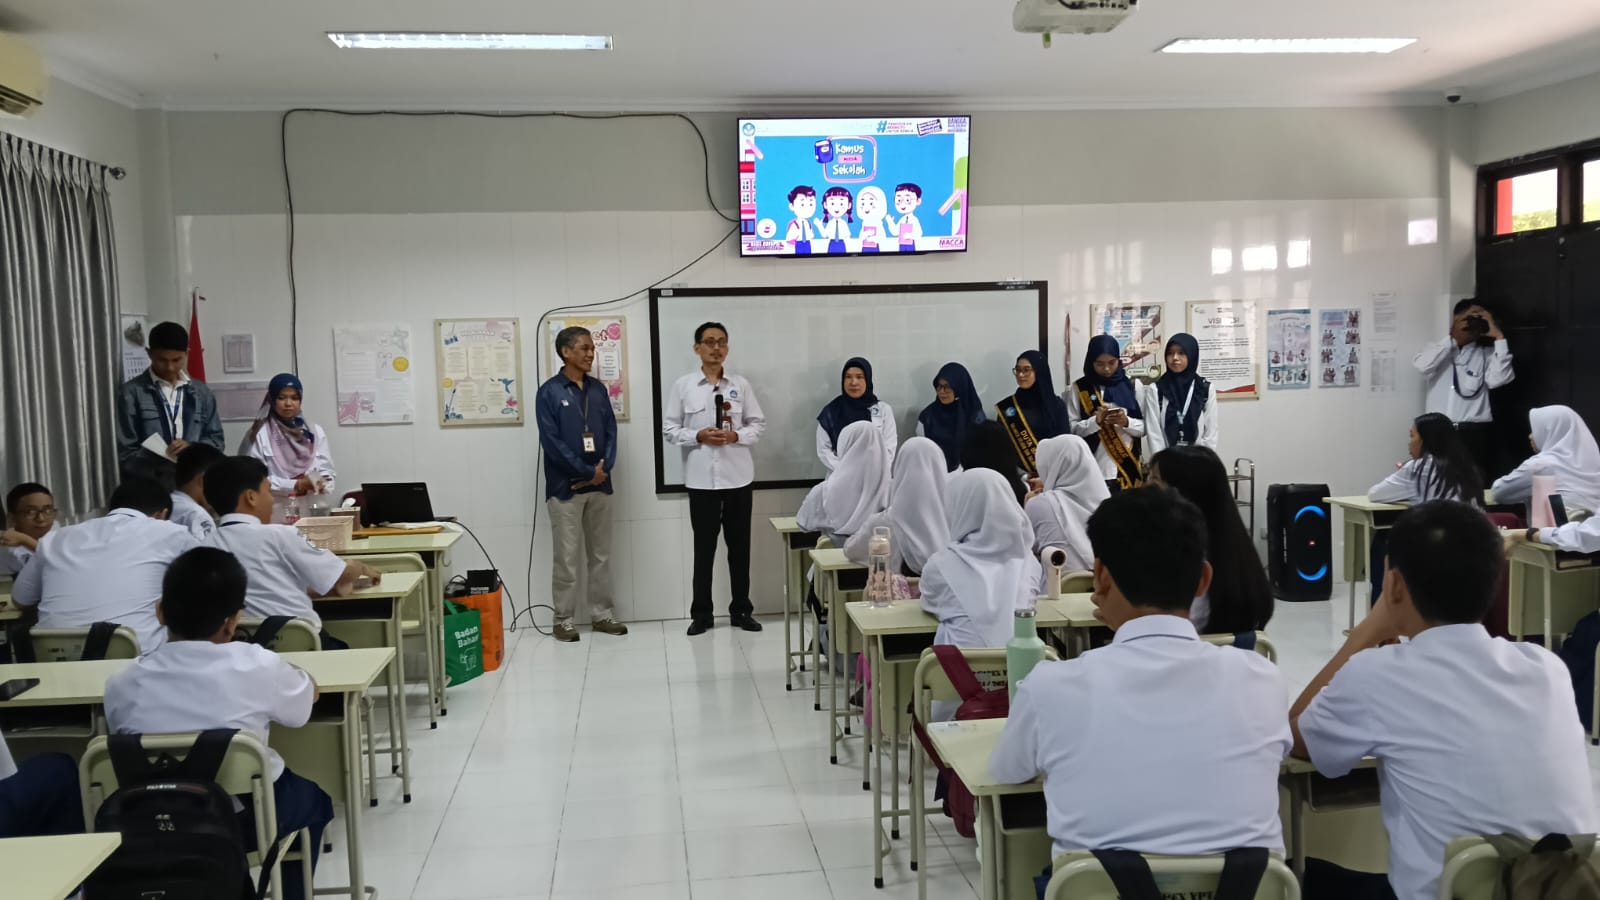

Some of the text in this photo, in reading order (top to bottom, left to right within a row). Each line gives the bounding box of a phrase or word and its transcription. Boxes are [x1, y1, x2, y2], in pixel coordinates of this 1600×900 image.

[835, 143, 865, 155] Kamus
[832, 163, 866, 175] Sekolah
[454, 625, 479, 639] Badan
